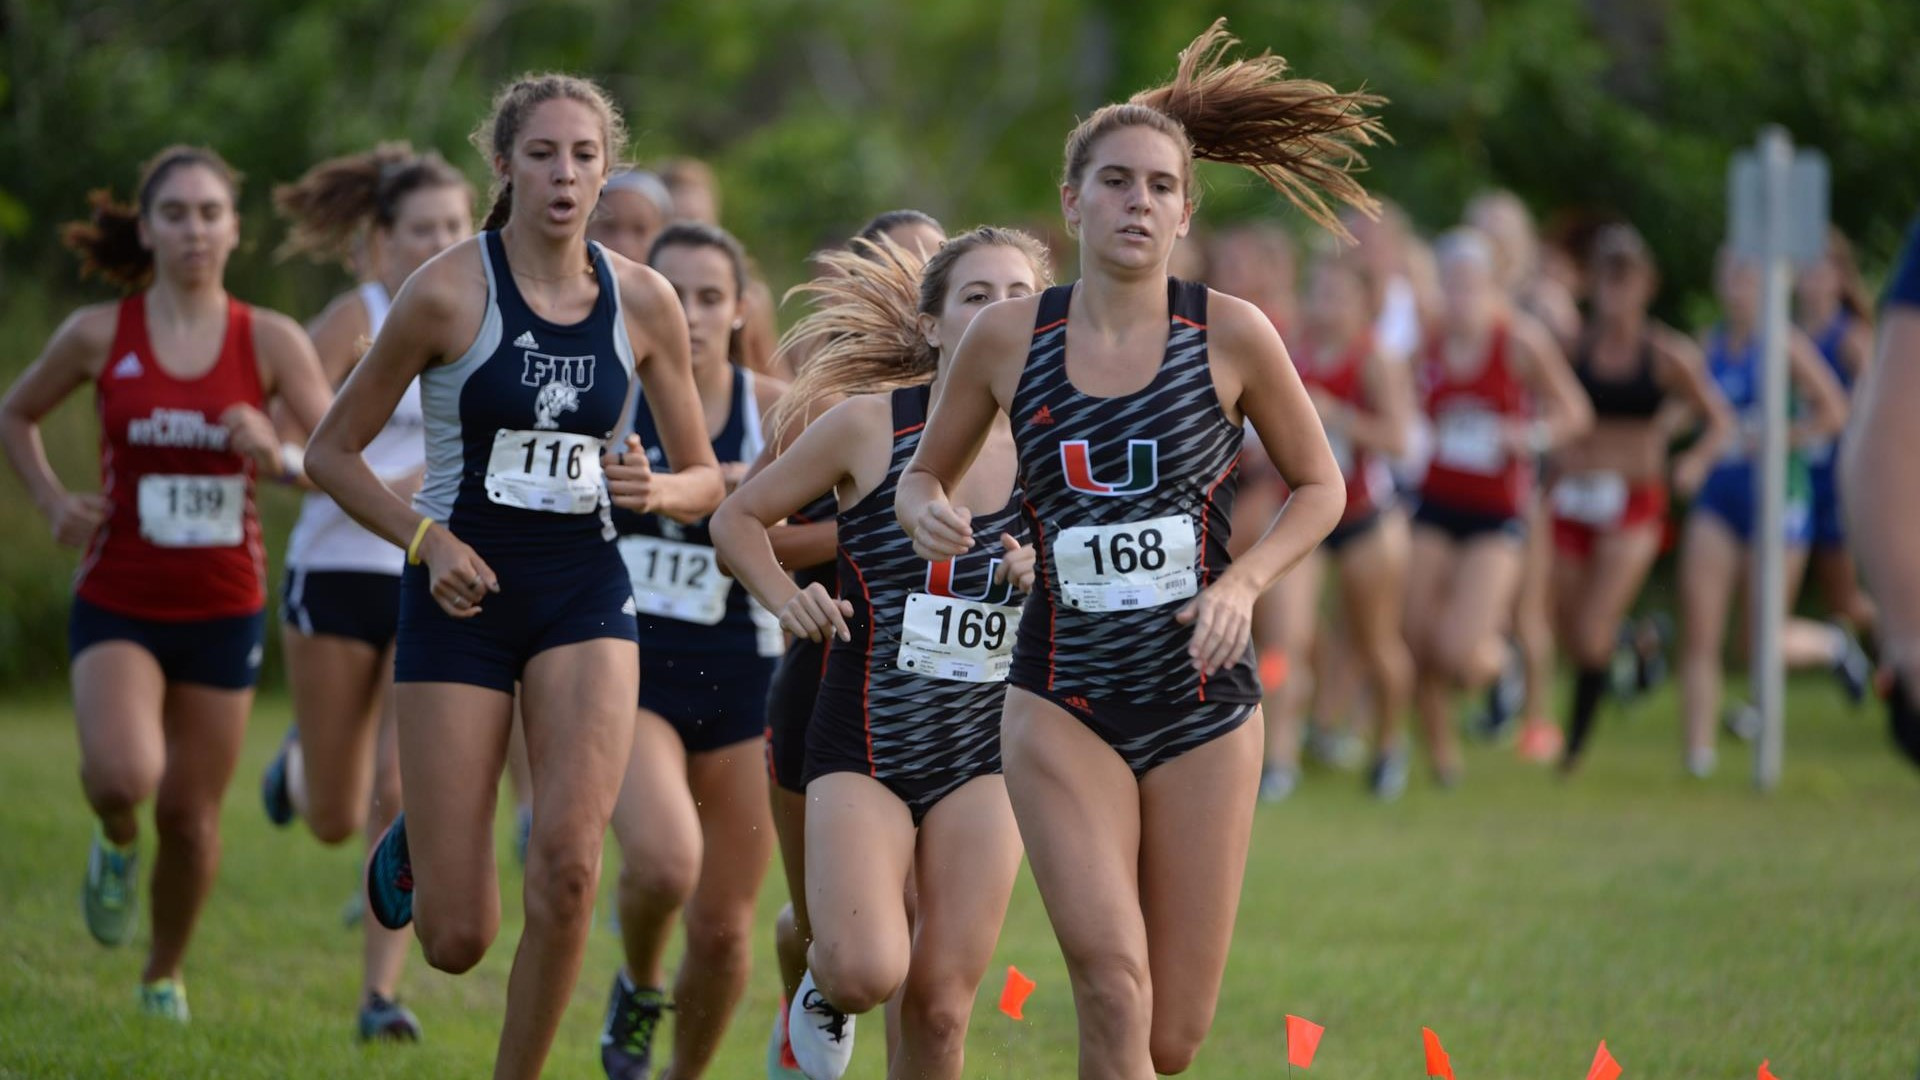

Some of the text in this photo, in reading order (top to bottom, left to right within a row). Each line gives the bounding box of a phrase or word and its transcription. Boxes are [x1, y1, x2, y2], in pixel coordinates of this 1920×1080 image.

[521, 350, 596, 393] FIU
[522, 437, 584, 480] 116
[1059, 439, 1159, 497] U
[167, 484, 224, 517] 139
[645, 544, 709, 590] 112
[1083, 528, 1167, 576] 168
[935, 605, 1007, 651] 169
